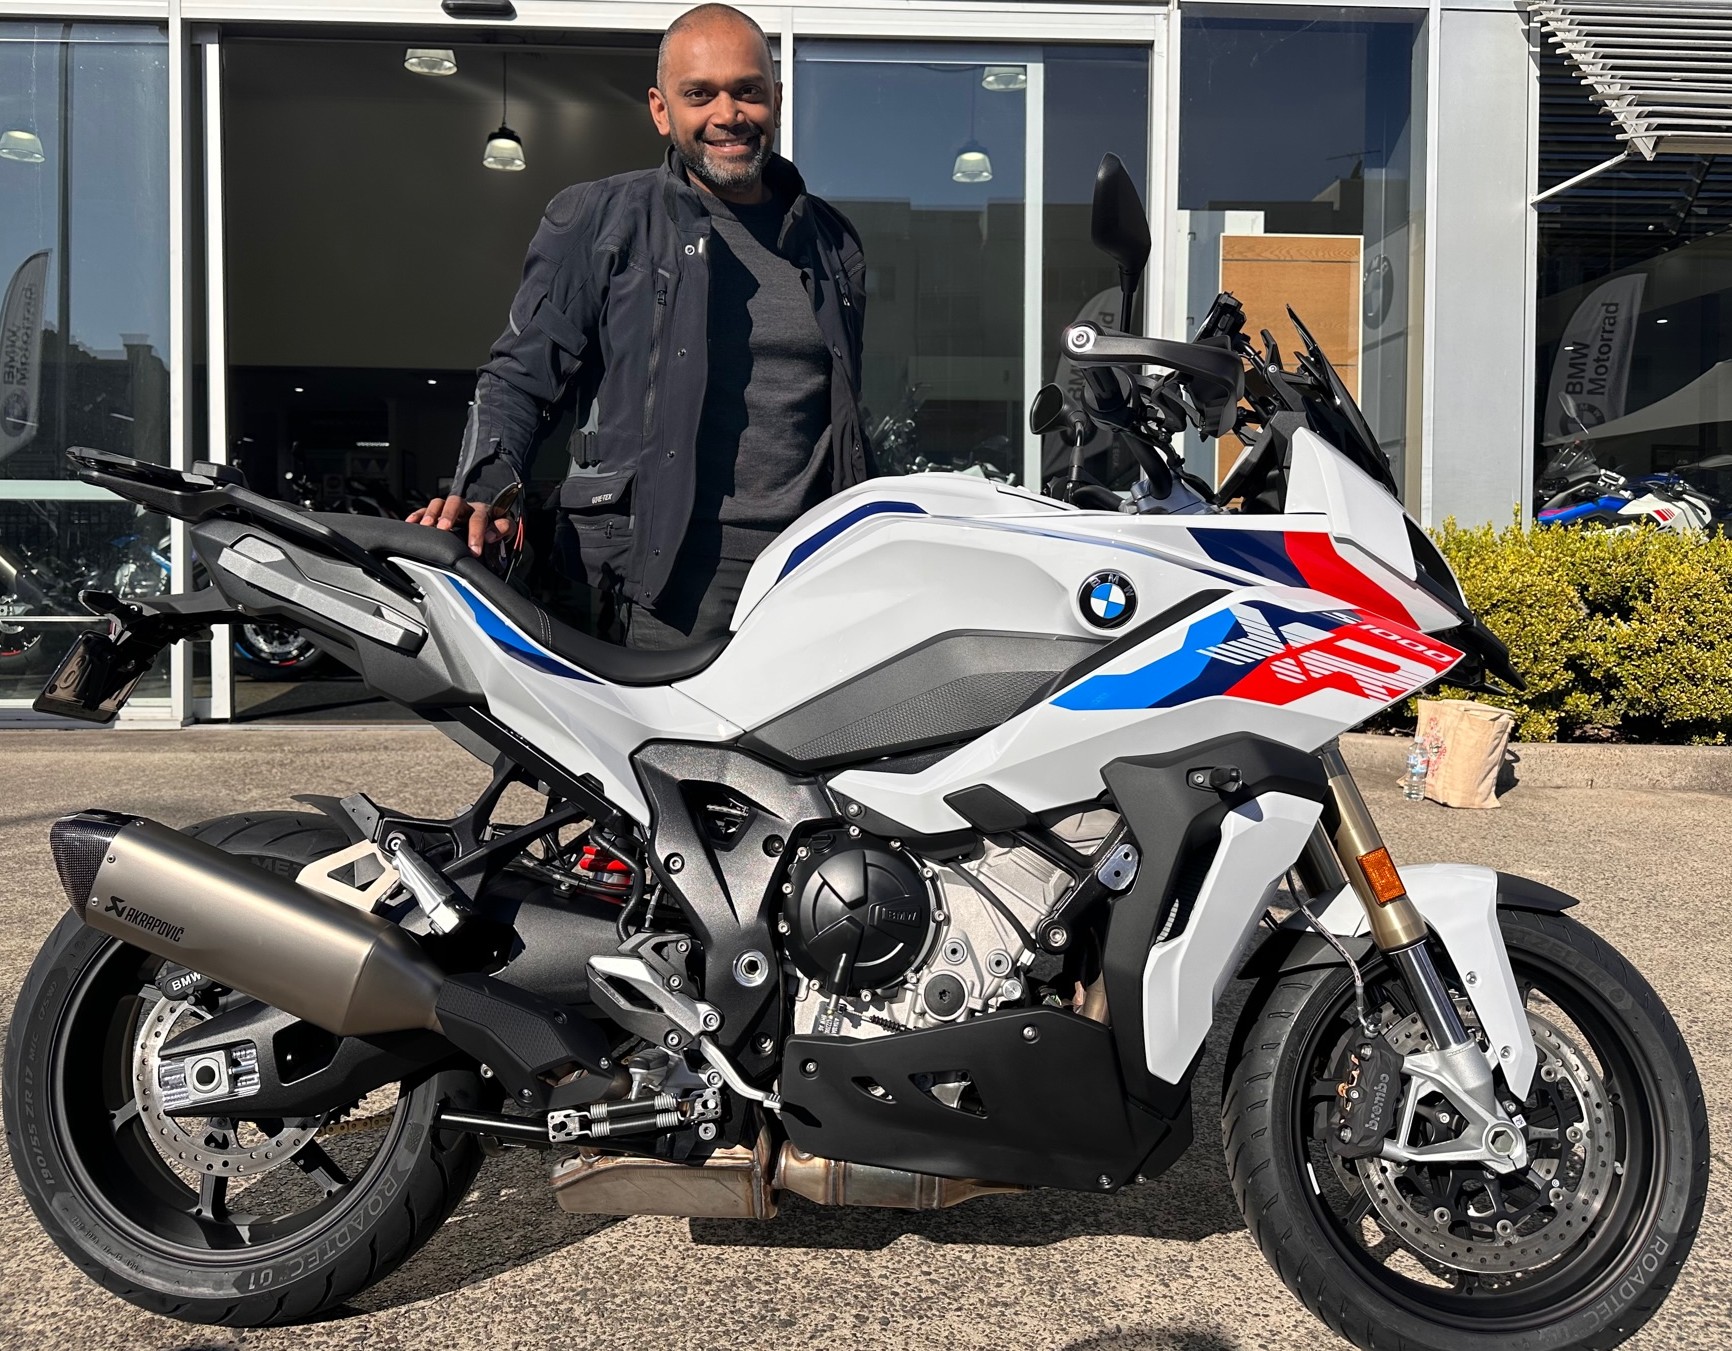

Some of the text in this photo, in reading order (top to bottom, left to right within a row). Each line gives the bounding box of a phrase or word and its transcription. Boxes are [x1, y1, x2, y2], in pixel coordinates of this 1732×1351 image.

[3, 326, 20, 386] BMW
[1564, 341, 1591, 396] BMW
[1586, 302, 1620, 397] Motorrad
[1089, 572, 1135, 597] BMW
[1357, 623, 1457, 664] 1000
[124, 907, 186, 943] AKRAPOVIČ
[171, 971, 202, 991] BMW
[24, 1066, 34, 1085] 17
[1364, 1073, 1390, 1131] brembo
[24, 1089, 35, 1119] ZR
[27, 1123, 56, 1186] 190/55
[248, 1170, 400, 1291] ROADTEC 01
[1583, 1236, 1670, 1333] ROADTEC
